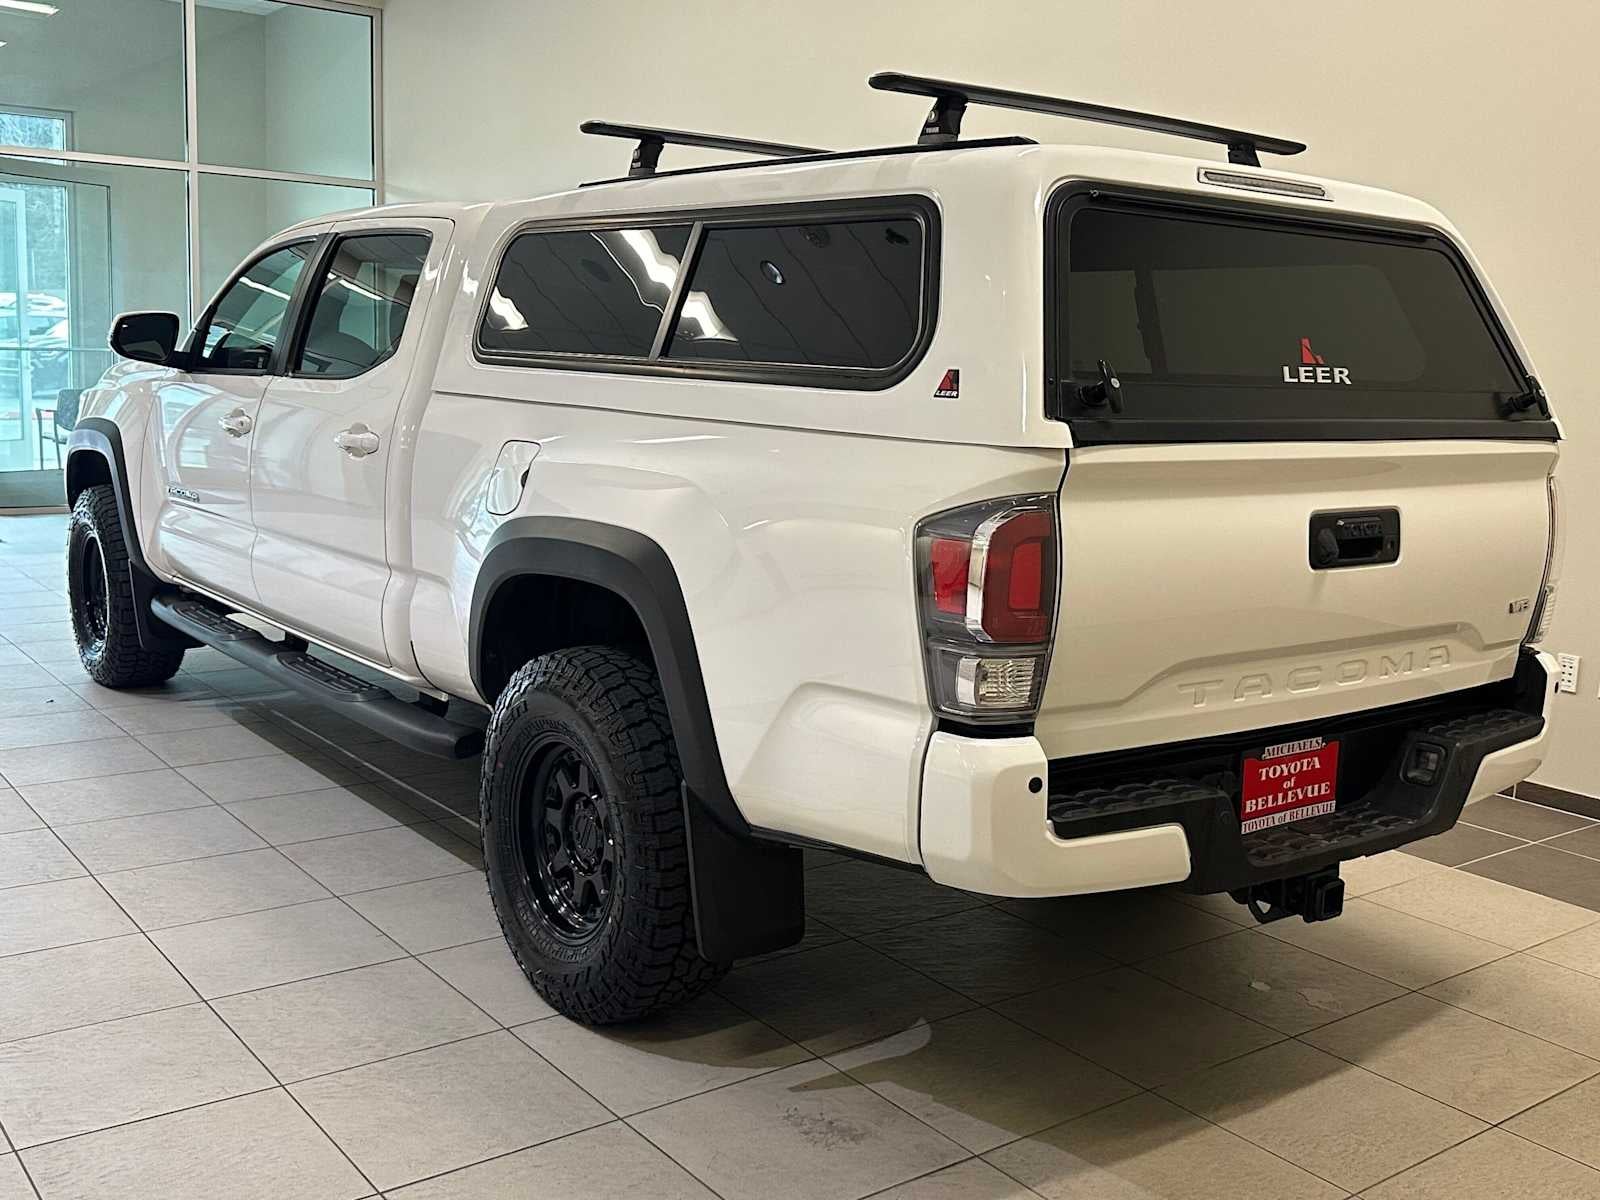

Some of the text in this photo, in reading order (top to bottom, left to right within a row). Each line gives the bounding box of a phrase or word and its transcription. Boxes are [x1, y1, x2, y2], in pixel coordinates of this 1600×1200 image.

[1282, 365, 1352, 385] LEER
[1177, 645, 1451, 708] TACOMA
[1259, 757, 1320, 781] TOYOTA
[1283, 777, 1296, 789] of
[1245, 782, 1330, 813] BELLEVUE
[1243, 802, 1334, 833] TOYOTA of BELLEVUE
